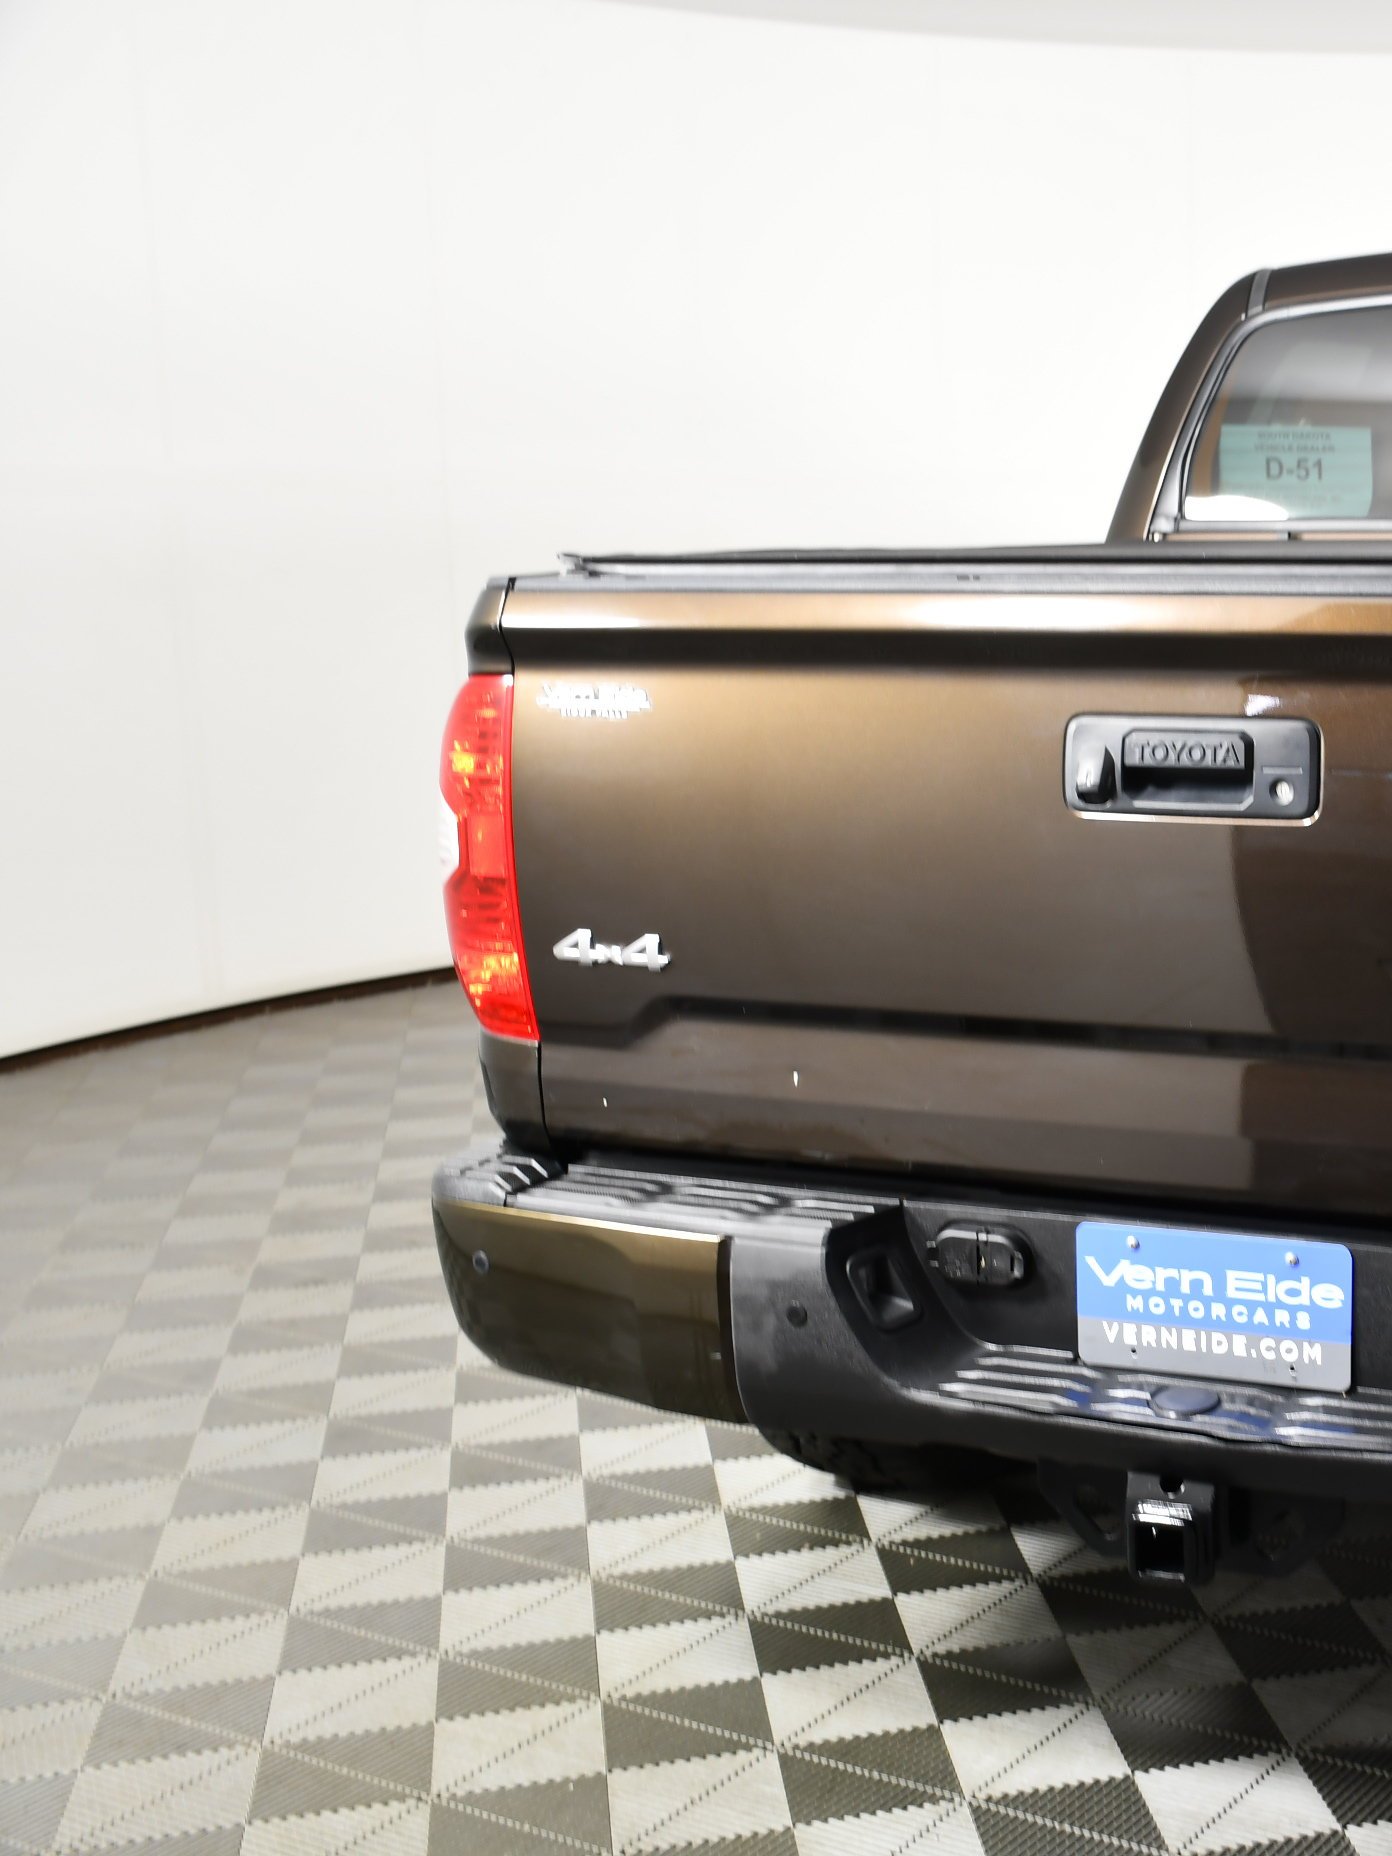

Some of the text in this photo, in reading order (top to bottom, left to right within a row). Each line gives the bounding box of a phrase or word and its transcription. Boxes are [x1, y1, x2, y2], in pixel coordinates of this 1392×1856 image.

[1265, 457, 1324, 481] D-51
[1133, 739, 1241, 766] TOYOTA
[1084, 1255, 1214, 1296] Vern
[1125, 1293, 1312, 1331] MOTORCARS
[1101, 1320, 1322, 1366] VERNEIDE.COM
